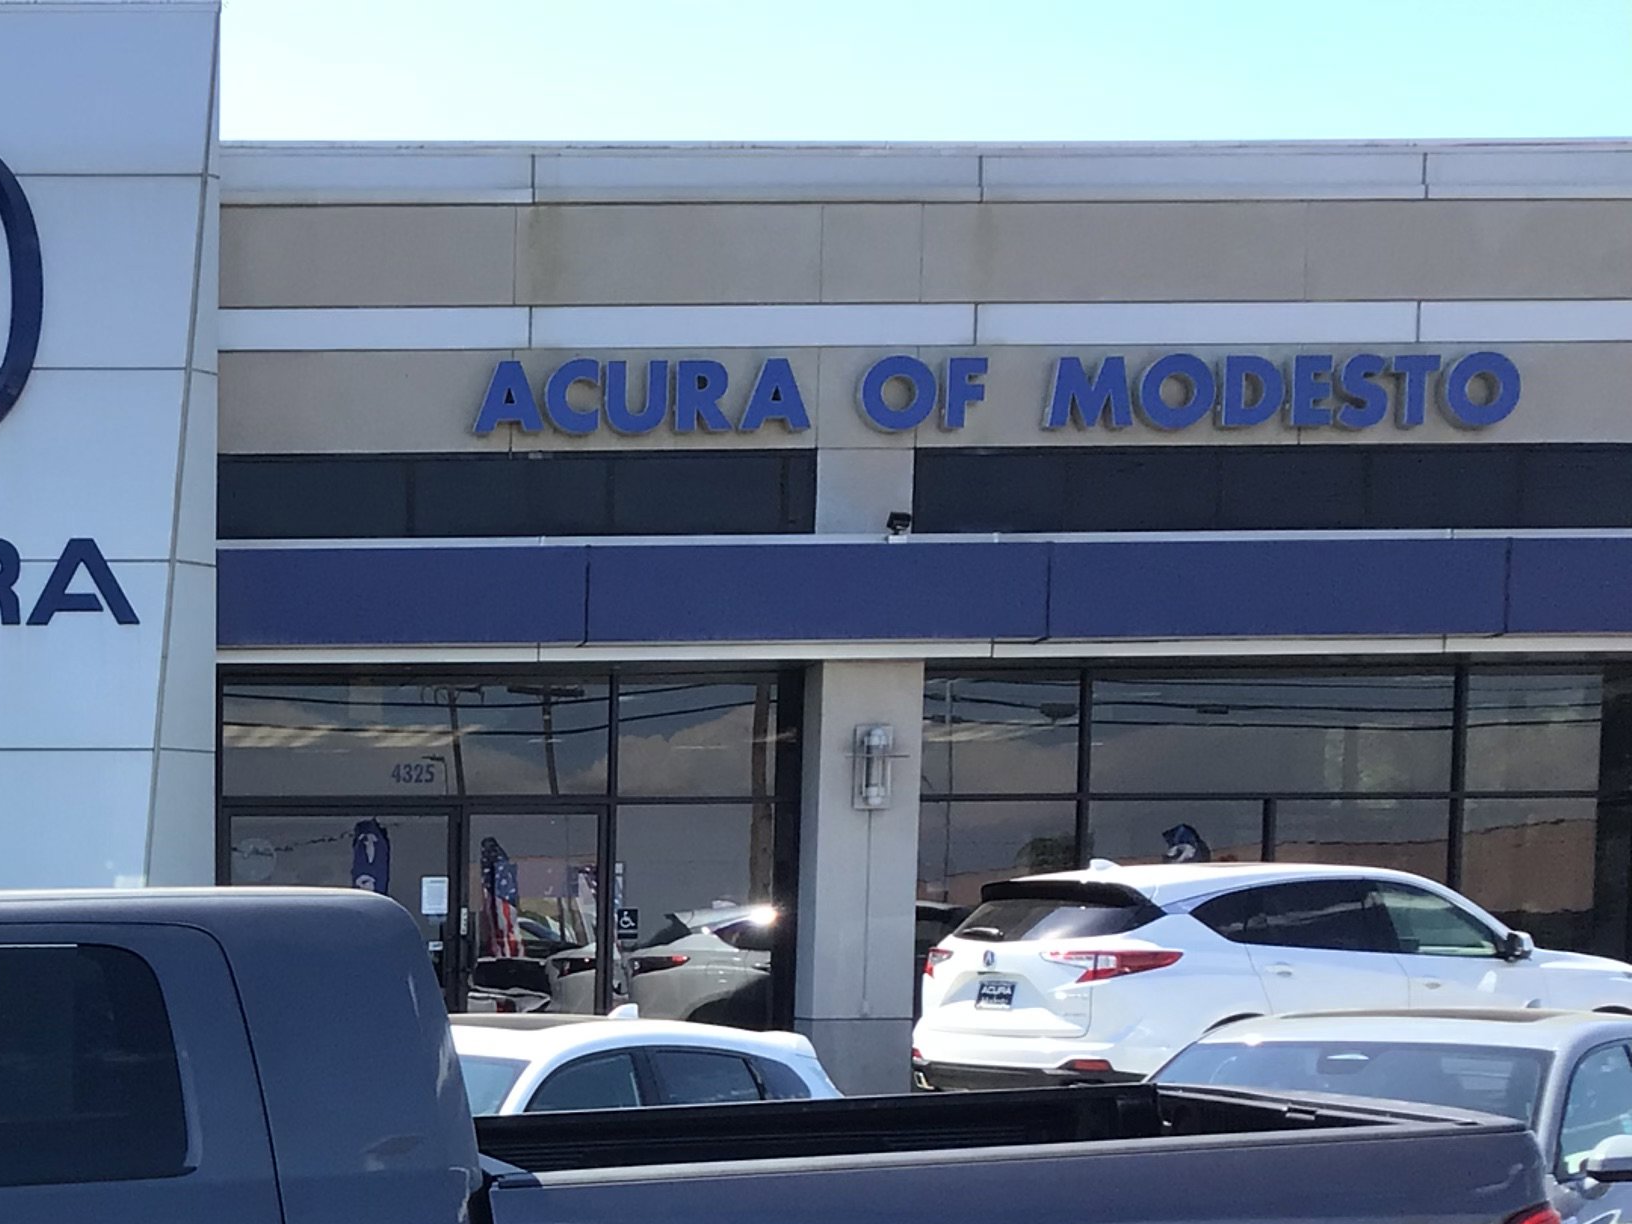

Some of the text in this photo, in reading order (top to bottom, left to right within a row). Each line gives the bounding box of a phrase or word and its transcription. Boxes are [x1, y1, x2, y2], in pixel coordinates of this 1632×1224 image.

[472, 351, 1521, 435] ACURA OF MODESTO
[391, 763, 435, 783] 4325
